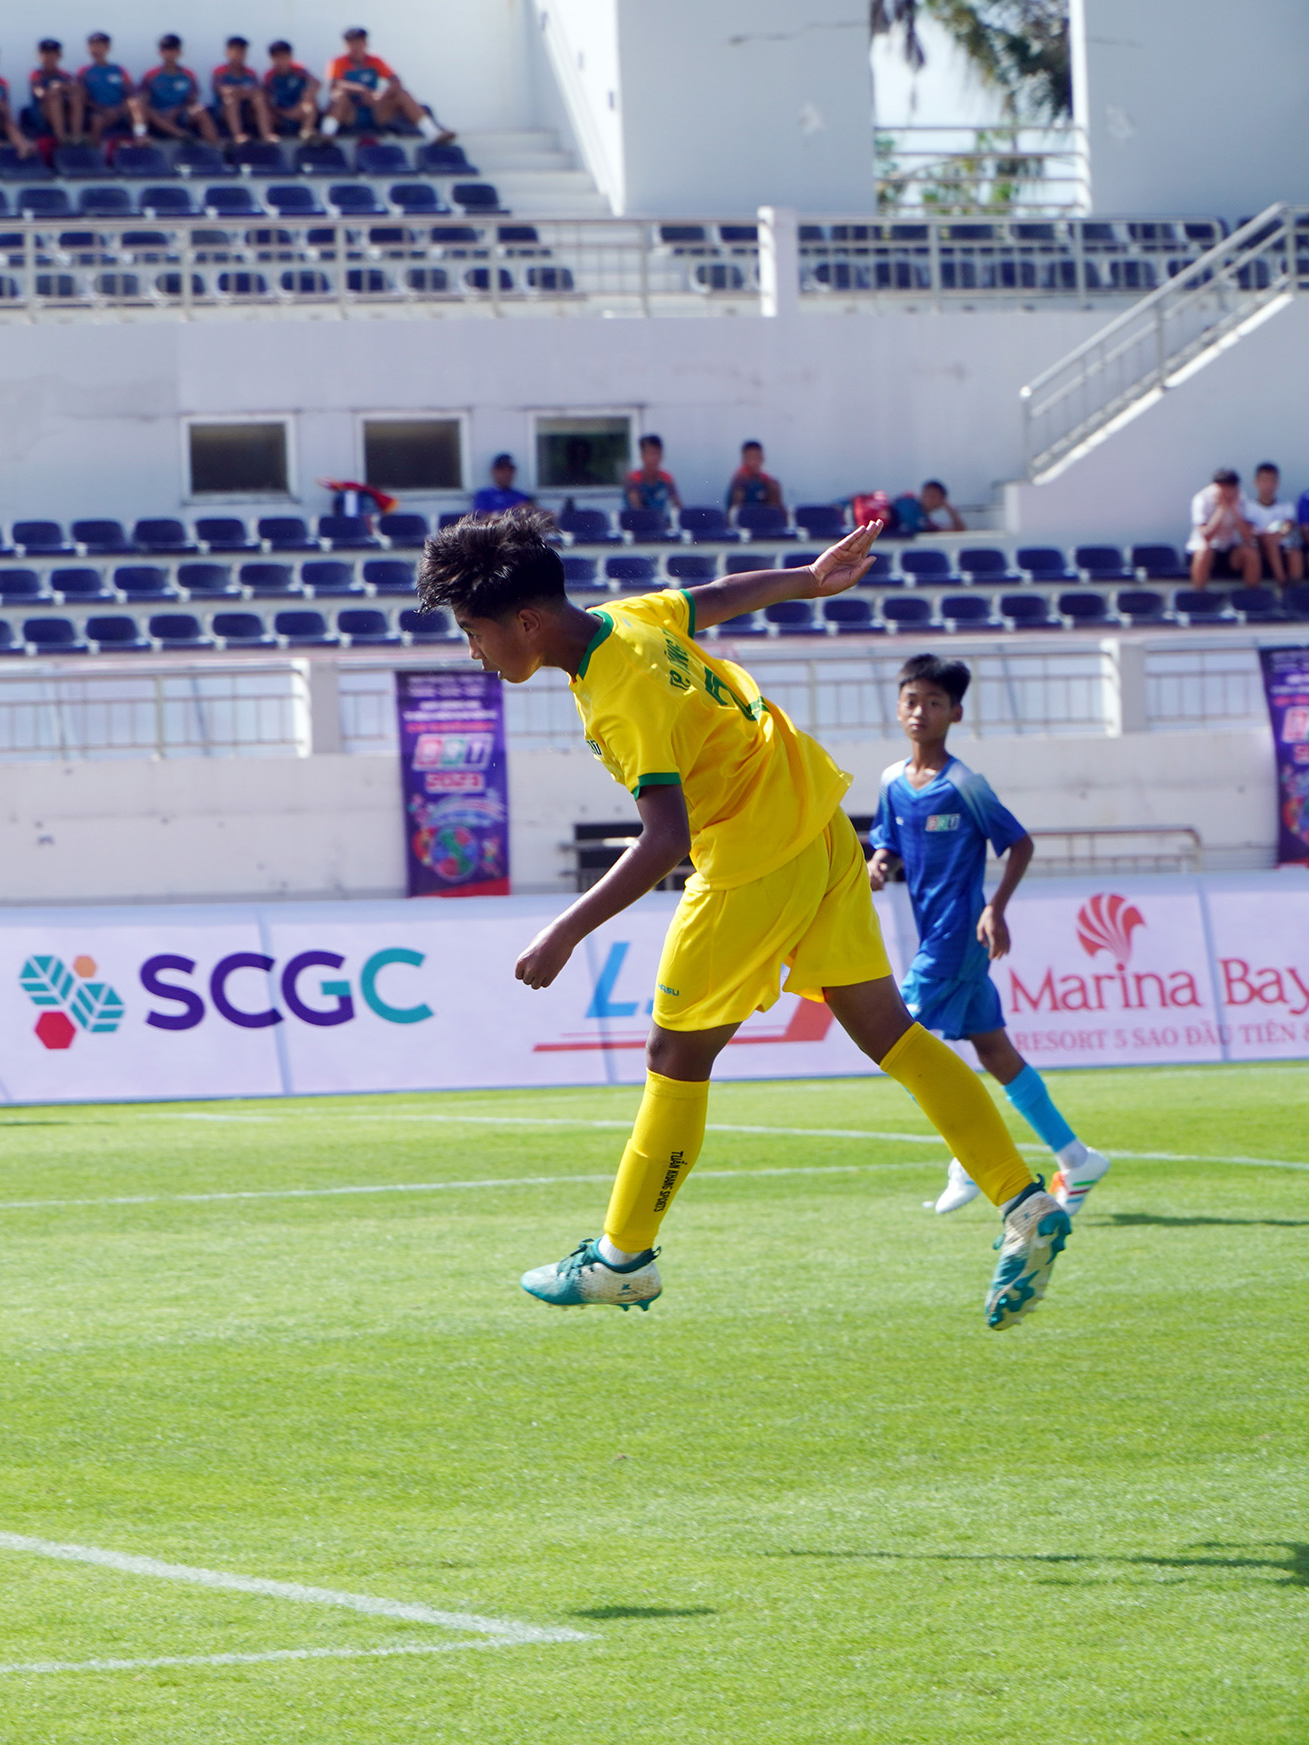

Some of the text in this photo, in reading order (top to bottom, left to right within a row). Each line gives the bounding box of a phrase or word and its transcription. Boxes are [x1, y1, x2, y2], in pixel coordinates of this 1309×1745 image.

[139, 946, 435, 1032] SCGC
[1008, 958, 1309, 1016] Marina Bay
[1014, 1028, 1107, 1051] RESORT
[1115, 1029, 1128, 1049] 5
[1132, 1026, 1179, 1049] SAO
